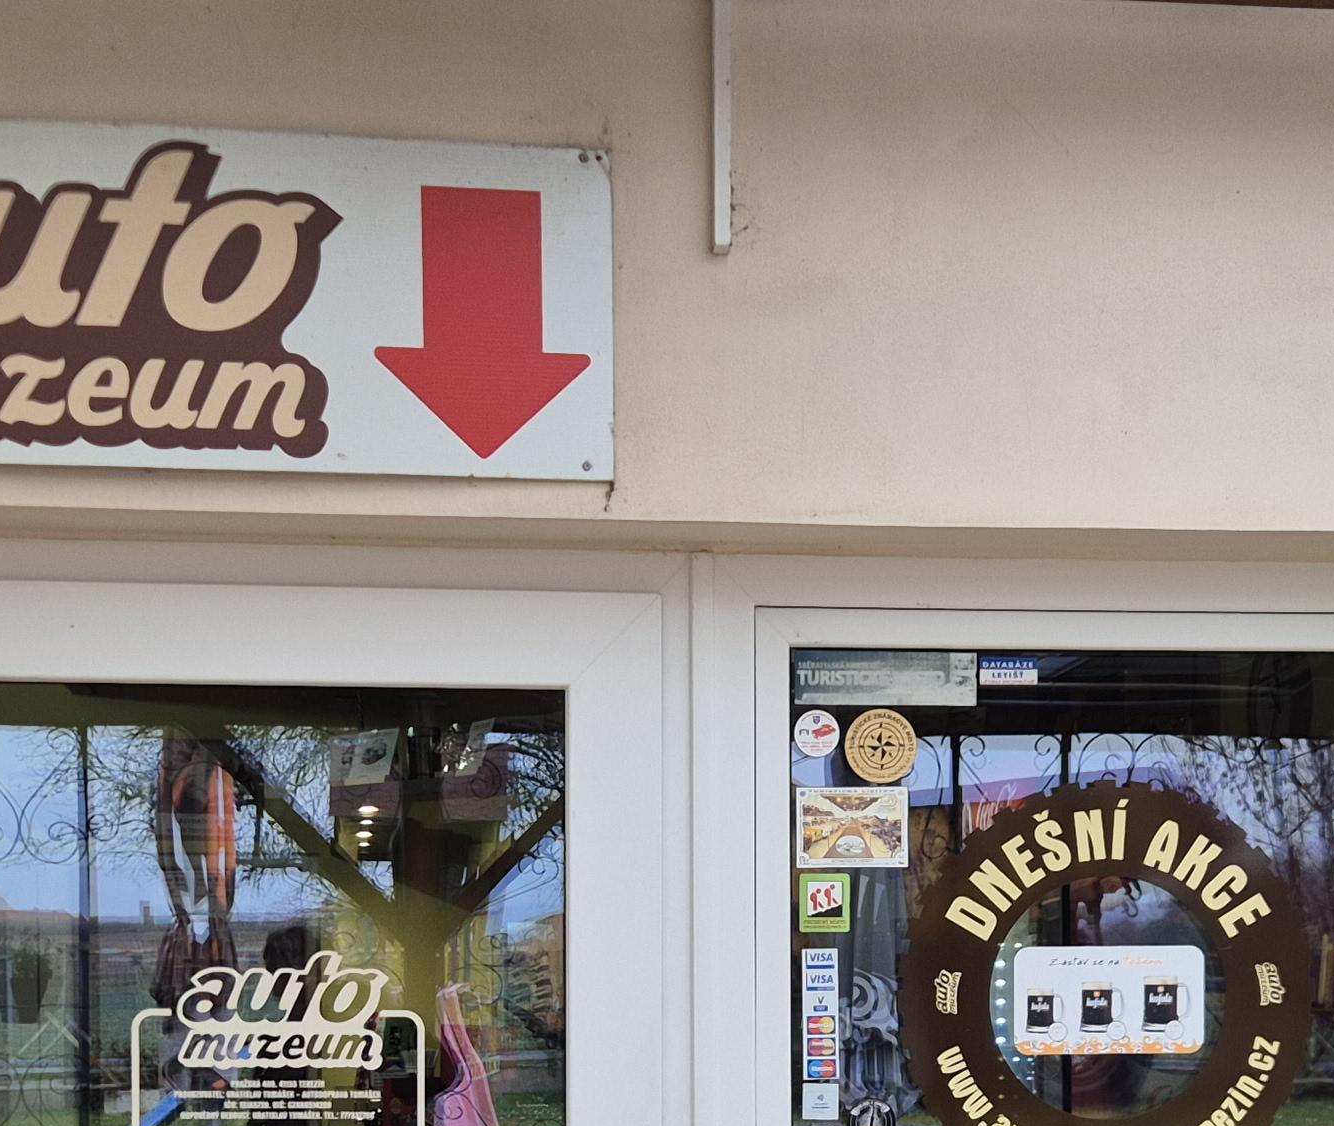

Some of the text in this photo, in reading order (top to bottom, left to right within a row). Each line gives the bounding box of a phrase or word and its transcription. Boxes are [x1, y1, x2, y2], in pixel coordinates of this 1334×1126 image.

[982, 659, 1034, 669] DATABÁZE
[944, 798, 1130, 942] DNEŠNÍ
[1143, 818, 1272, 939] AKCE
[809, 952, 834, 962] VISA
[178, 951, 388, 1026] auto
[810, 974, 834, 984] VISA
[934, 969, 952, 1013] auto
[1263, 962, 1286, 1004] auto
[181, 1031, 381, 1067] muzeum
